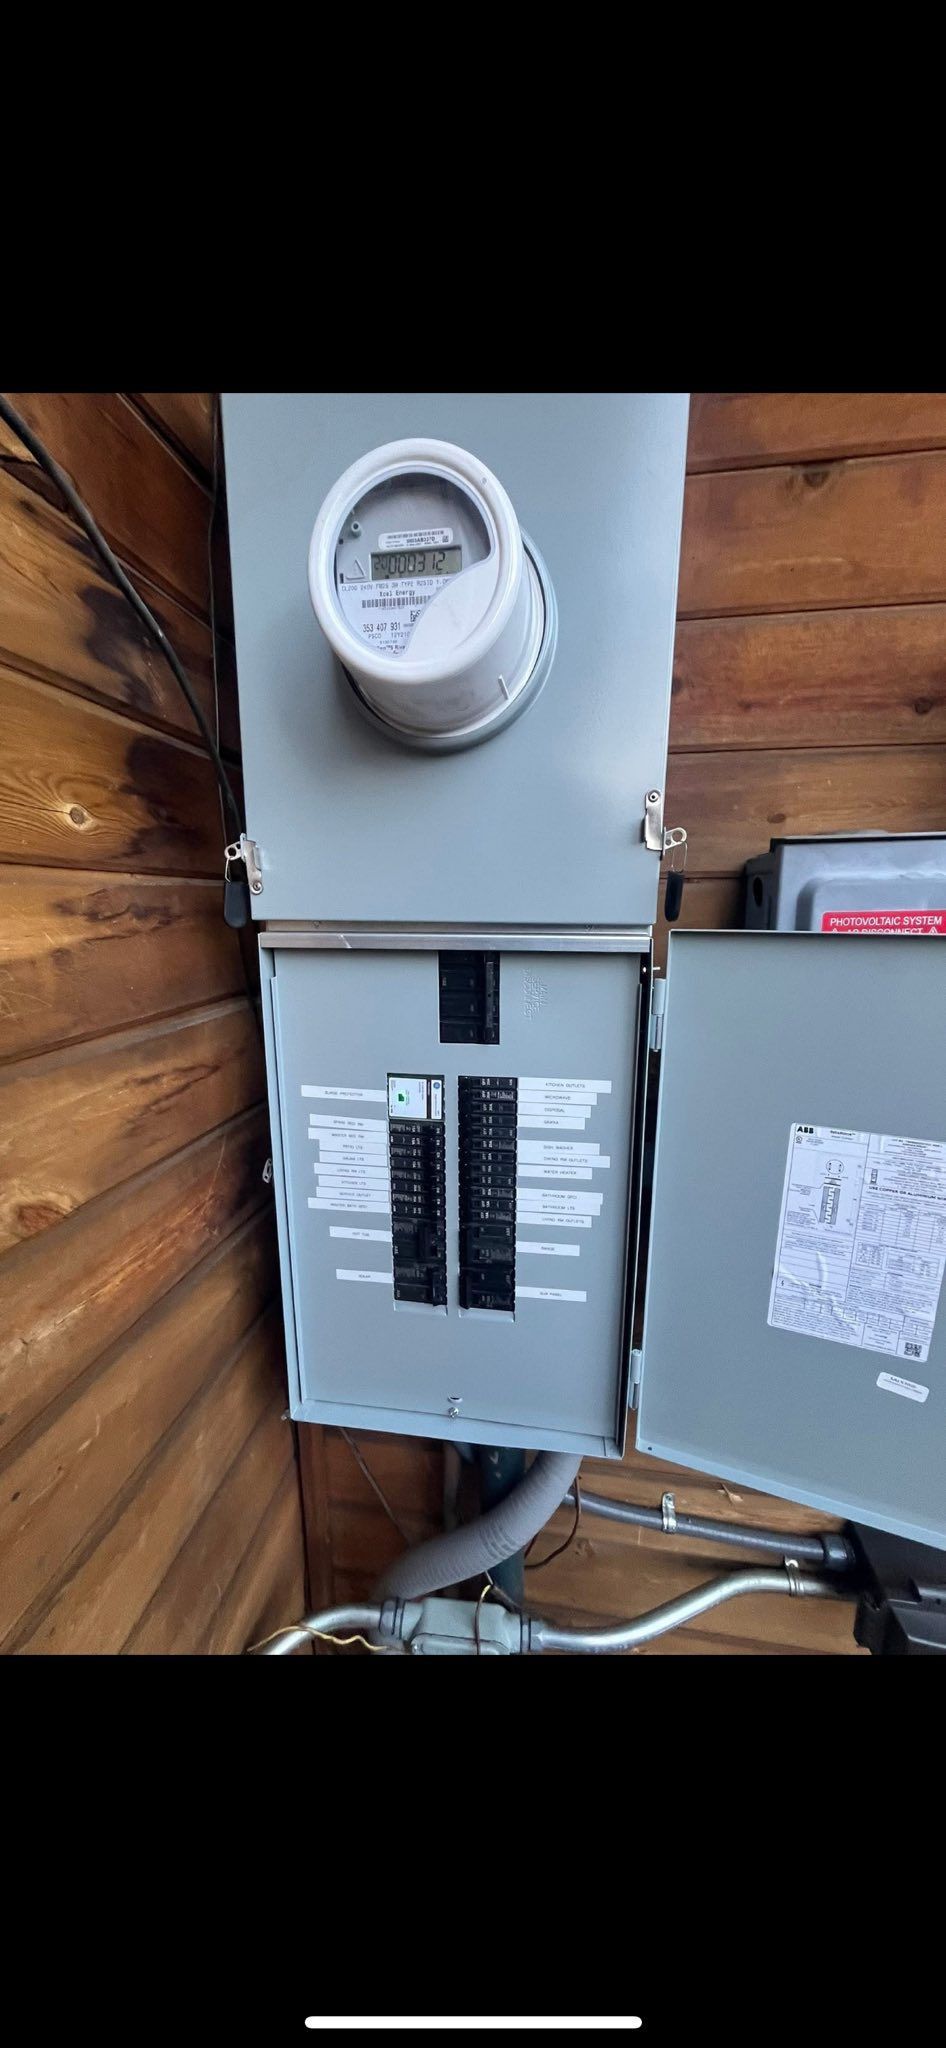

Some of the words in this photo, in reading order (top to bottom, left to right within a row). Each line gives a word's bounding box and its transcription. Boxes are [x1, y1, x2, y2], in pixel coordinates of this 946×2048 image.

[363, 624, 374, 633] 353
[376, 623, 387, 632] 407
[390, 622, 401, 631] 931
[830, 917, 900, 926] PHOTOVOLTAIC
[903, 916, 942, 925] SYSTEM
